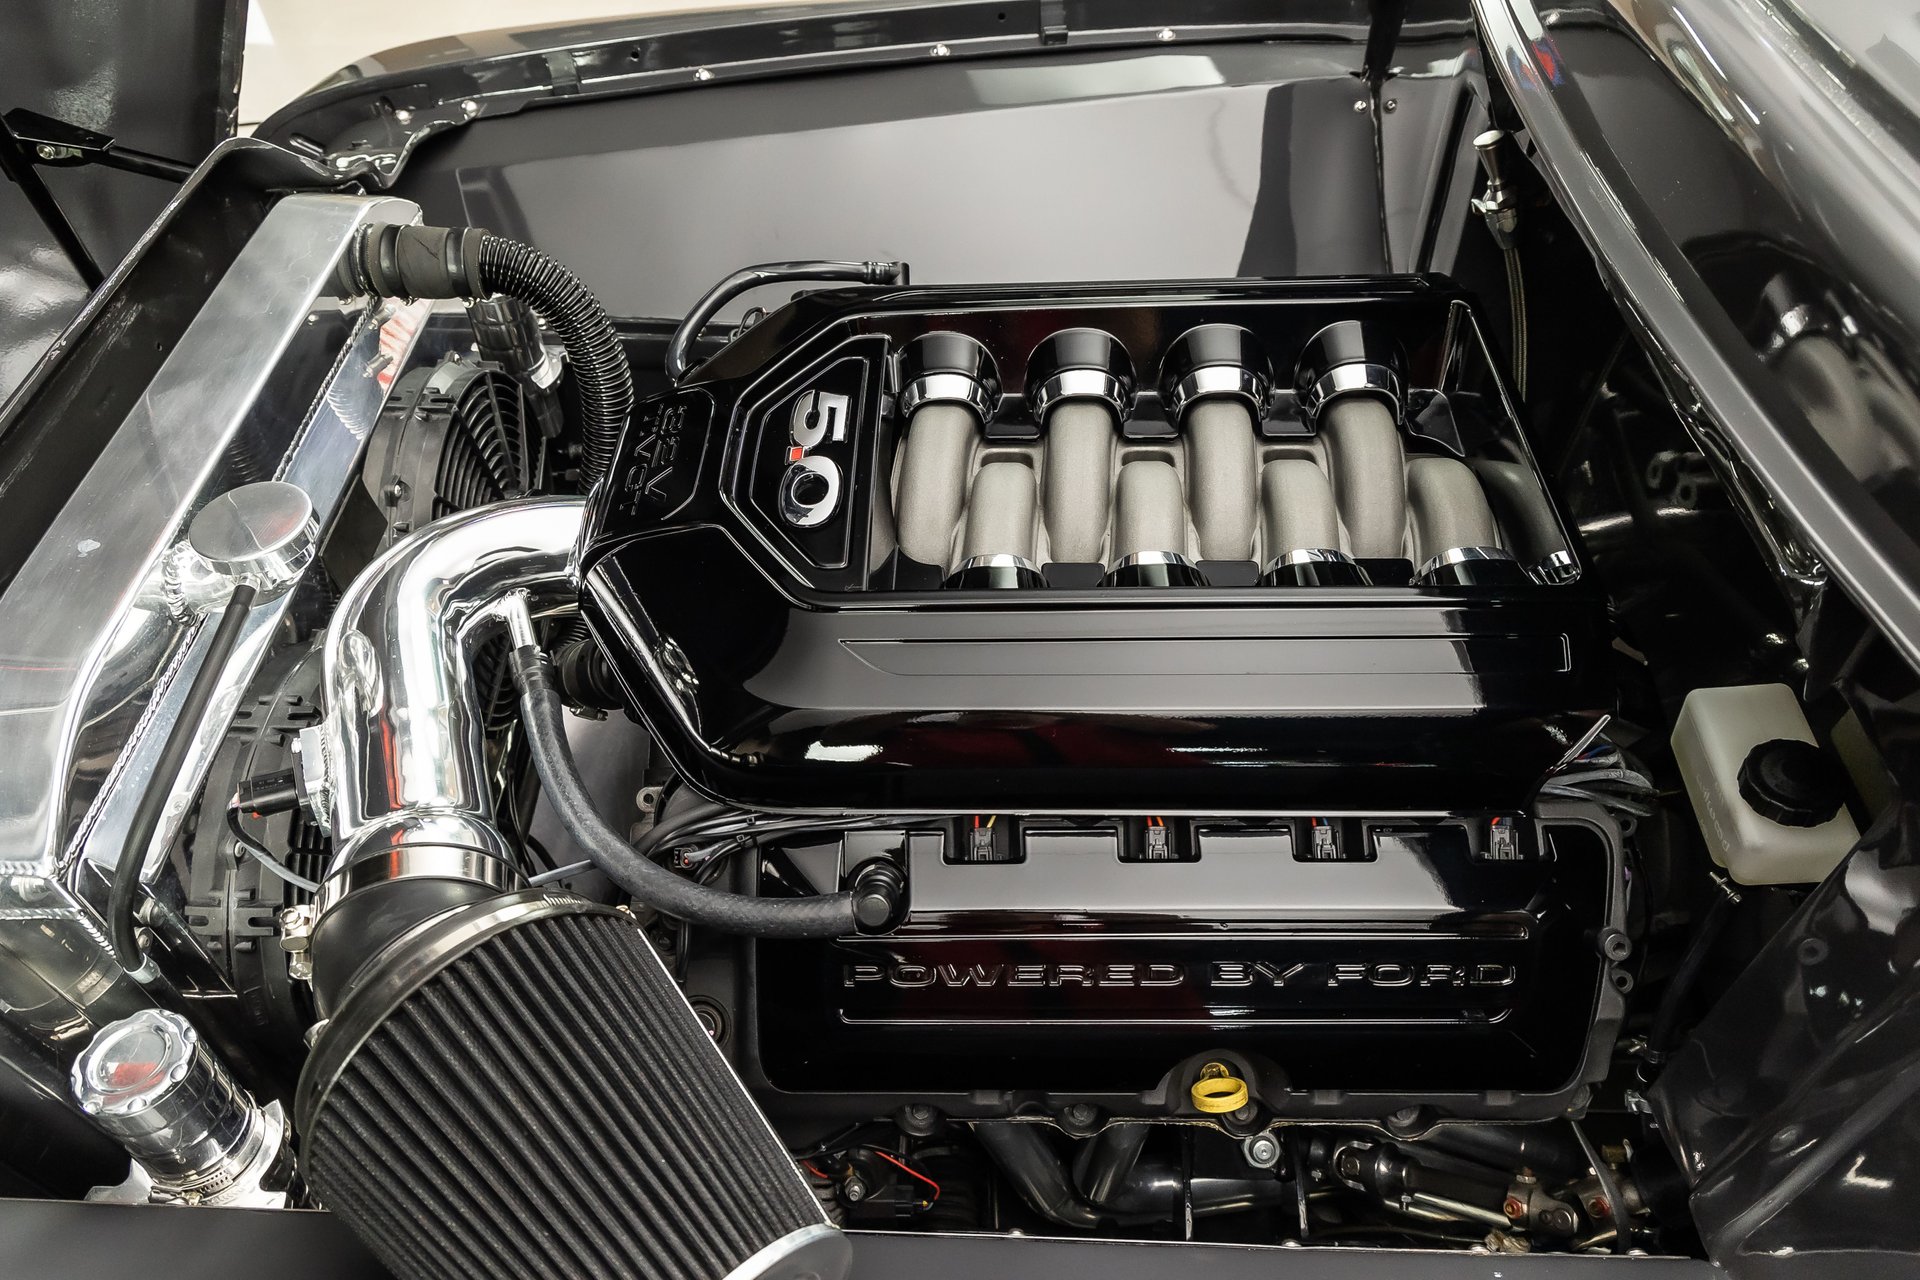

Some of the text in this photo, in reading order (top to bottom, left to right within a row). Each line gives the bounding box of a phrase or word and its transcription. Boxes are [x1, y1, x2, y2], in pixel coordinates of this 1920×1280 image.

[780, 390, 849, 528] 5.0
[843, 961, 1517, 987] POWERED BY FORD
